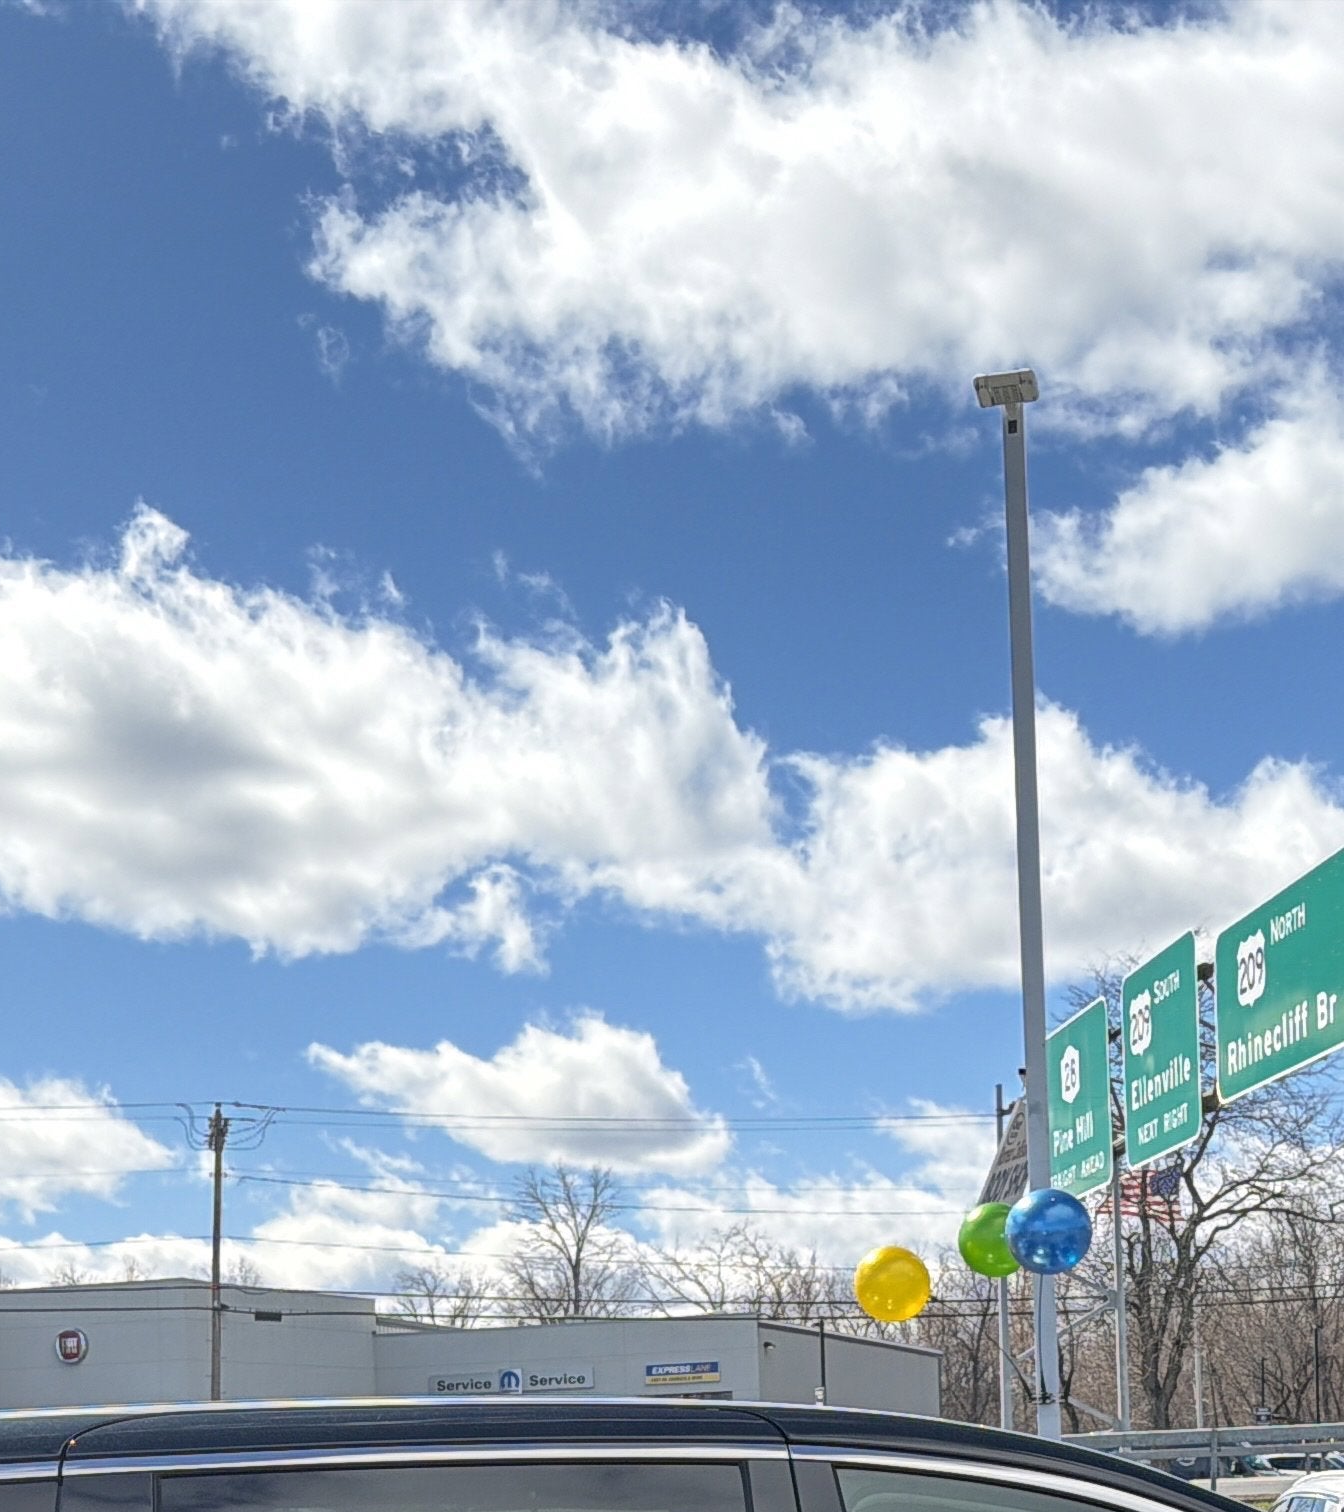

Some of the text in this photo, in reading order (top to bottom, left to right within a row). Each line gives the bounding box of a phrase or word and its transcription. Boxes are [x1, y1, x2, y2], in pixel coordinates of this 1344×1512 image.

[1270, 902, 1306, 946] NORTH
[1239, 946, 1264, 996] 209
[1131, 1004, 1151, 1047] 209
[1227, 991, 1338, 1076] Rhinecliff Br
[1131, 1053, 1191, 1111] Ellenville
[1053, 1128, 1074, 1158] Pine
[1075, 1110, 1094, 1145] Hill
[1137, 1102, 1189, 1146] NEXT RIGHT
[437, 1373, 586, 1392] Service Service
